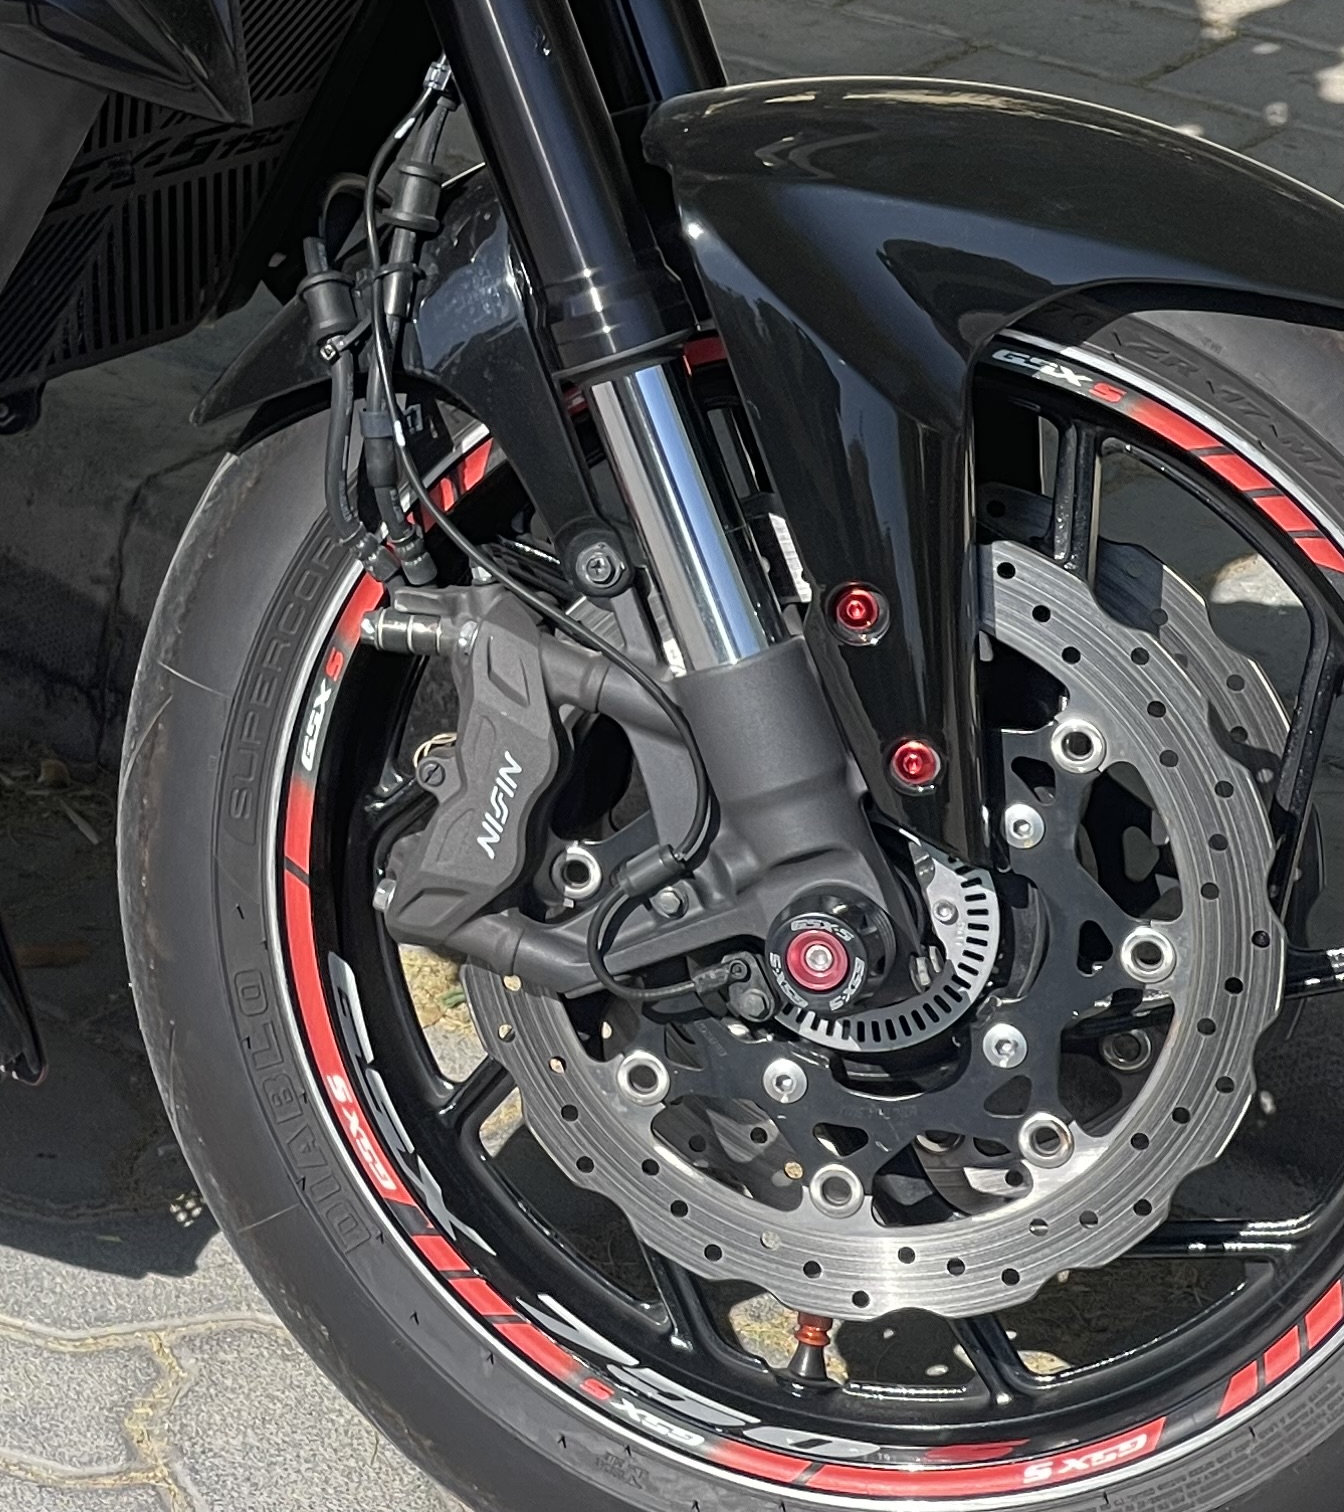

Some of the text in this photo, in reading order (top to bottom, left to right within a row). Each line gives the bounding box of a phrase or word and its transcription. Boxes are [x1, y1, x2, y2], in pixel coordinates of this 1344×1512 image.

[991, 347, 1128, 403] GSX S
[230, 536, 340, 821] SUPERCOR
[302, 647, 345, 772] GSX S
[477, 751, 523, 860] NISSIN
[233, 969, 372, 1254] DIABLO
[324, 1074, 398, 1191] GSX S
[578, 1376, 706, 1447] GSX S
[1021, 1431, 1148, 1485] GSX S
